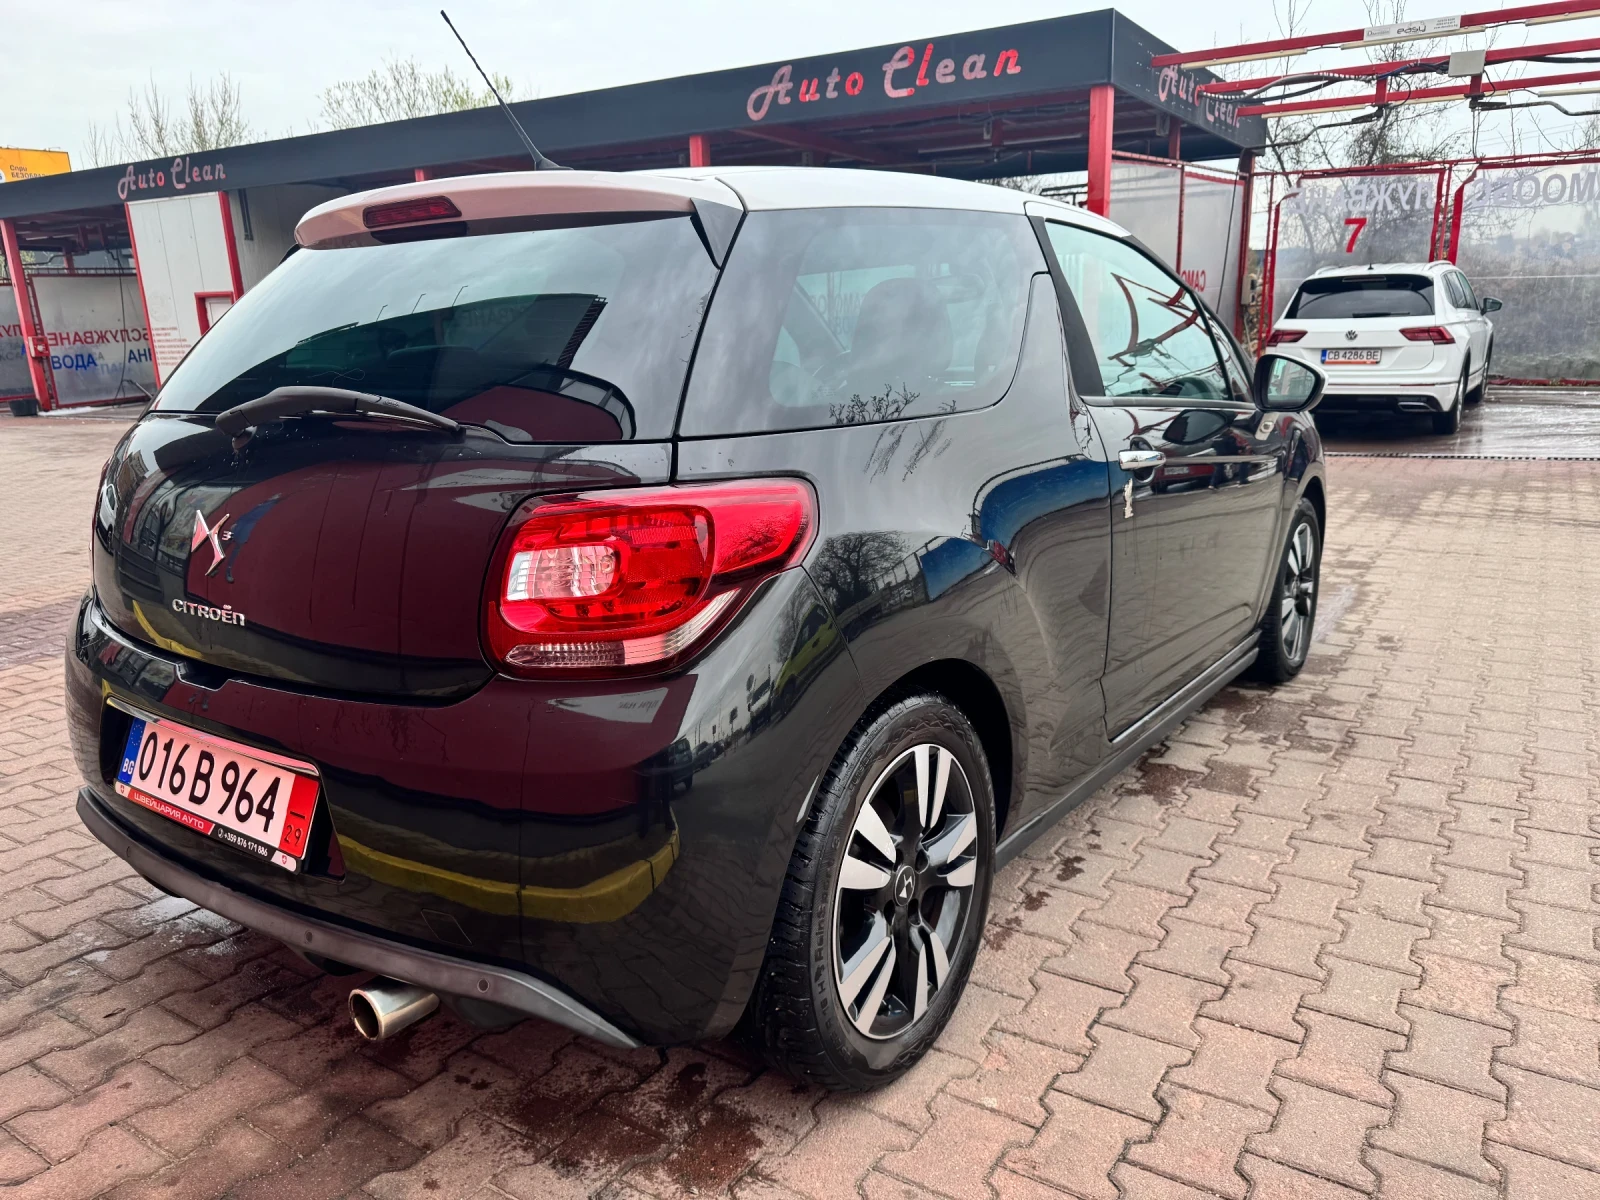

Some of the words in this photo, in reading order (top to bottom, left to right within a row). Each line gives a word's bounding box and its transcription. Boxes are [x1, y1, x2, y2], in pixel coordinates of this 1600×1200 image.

[746, 64, 864, 121] Auto
[881, 43, 1021, 98] Clean
[117, 165, 165, 200] Auto
[170, 156, 226, 189] Clean
[1344, 217, 1367, 253] 7
[50, 352, 98, 371] ВОДА
[1341, 350, 1365, 360] 4286
[172, 598, 245, 627] CITROËN
[122, 757, 135, 775] BG
[134, 792, 181, 819] ШВЕЙЦАРИЯ
[182, 814, 204, 830] АУТО
[224, 832, 237, 843] +359
[236, 837, 247, 848] 876
[248, 841, 257, 852] 171
[284, 824, 303, 847] 29
